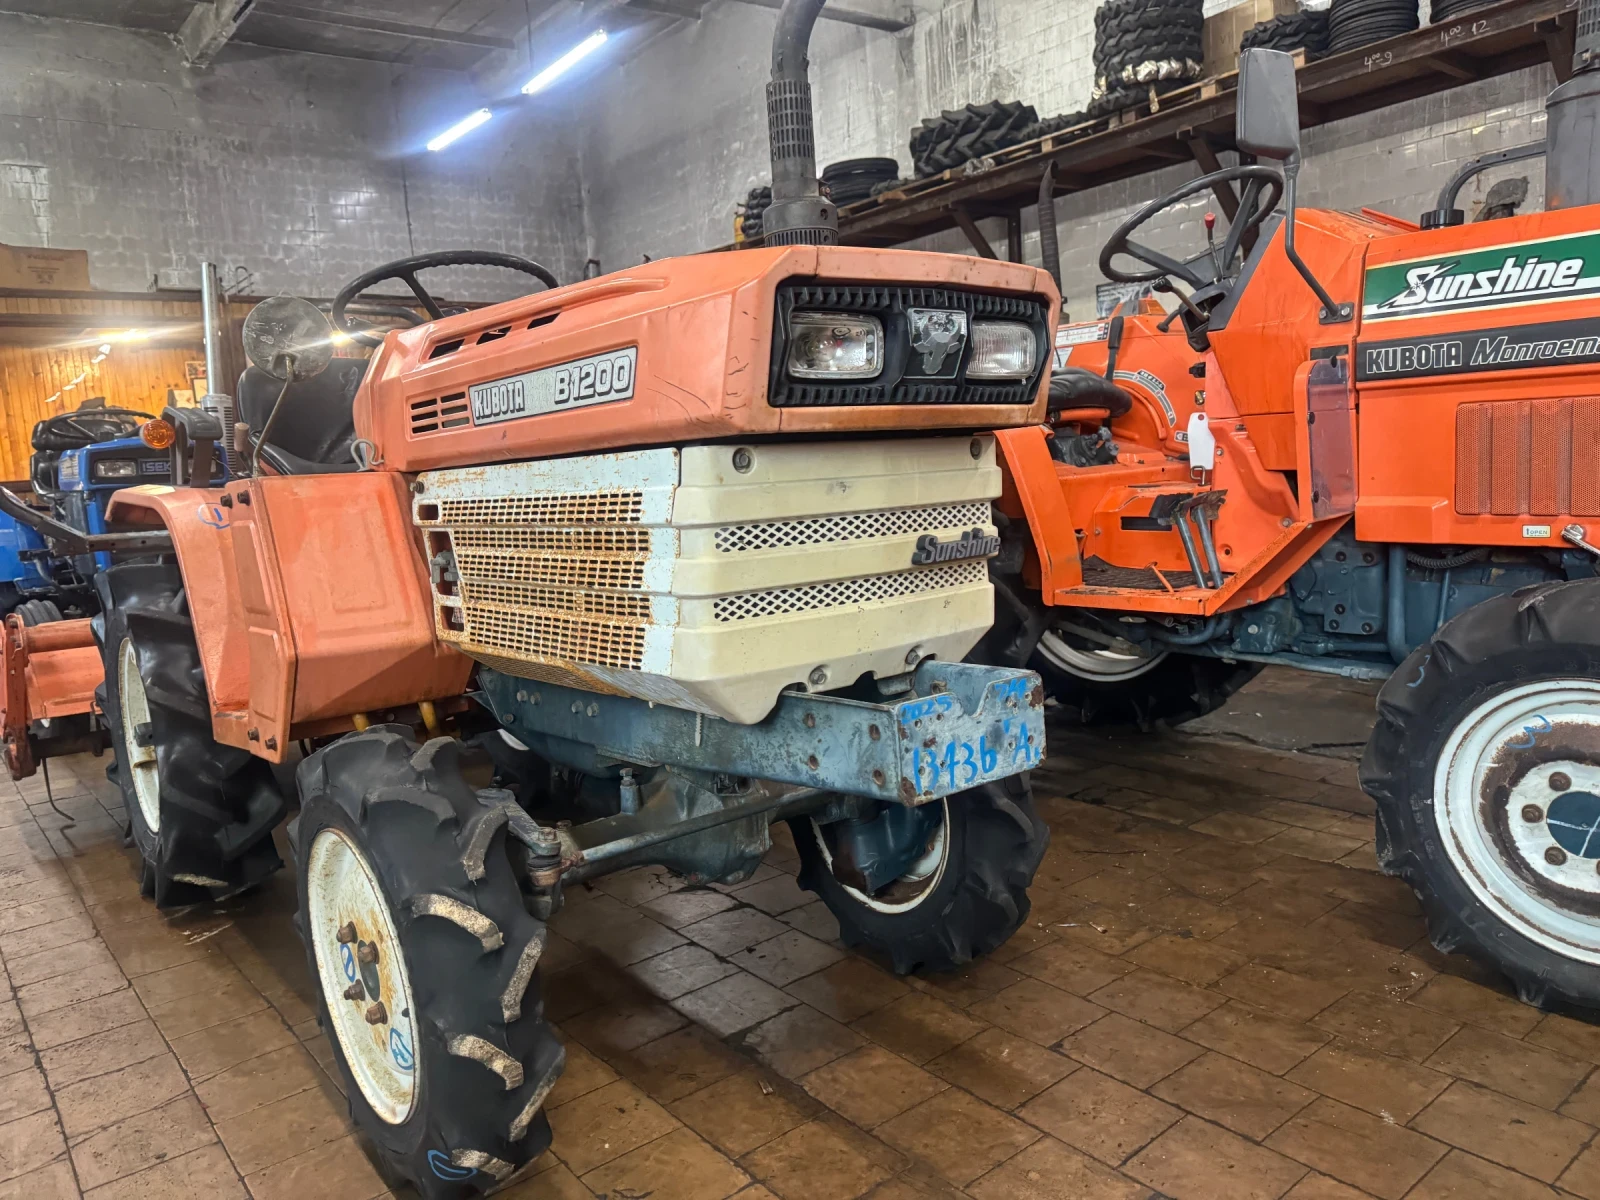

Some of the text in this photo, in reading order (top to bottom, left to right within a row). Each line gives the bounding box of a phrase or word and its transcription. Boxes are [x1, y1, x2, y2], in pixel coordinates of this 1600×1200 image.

[1377, 255, 1584, 309] Sunshine
[1366, 341, 1463, 374] KUBOTA
[473, 355, 632, 420] KUBOTA B1200
[142, 461, 171, 472] ISEK
[913, 528, 1001, 565] Sunshine
